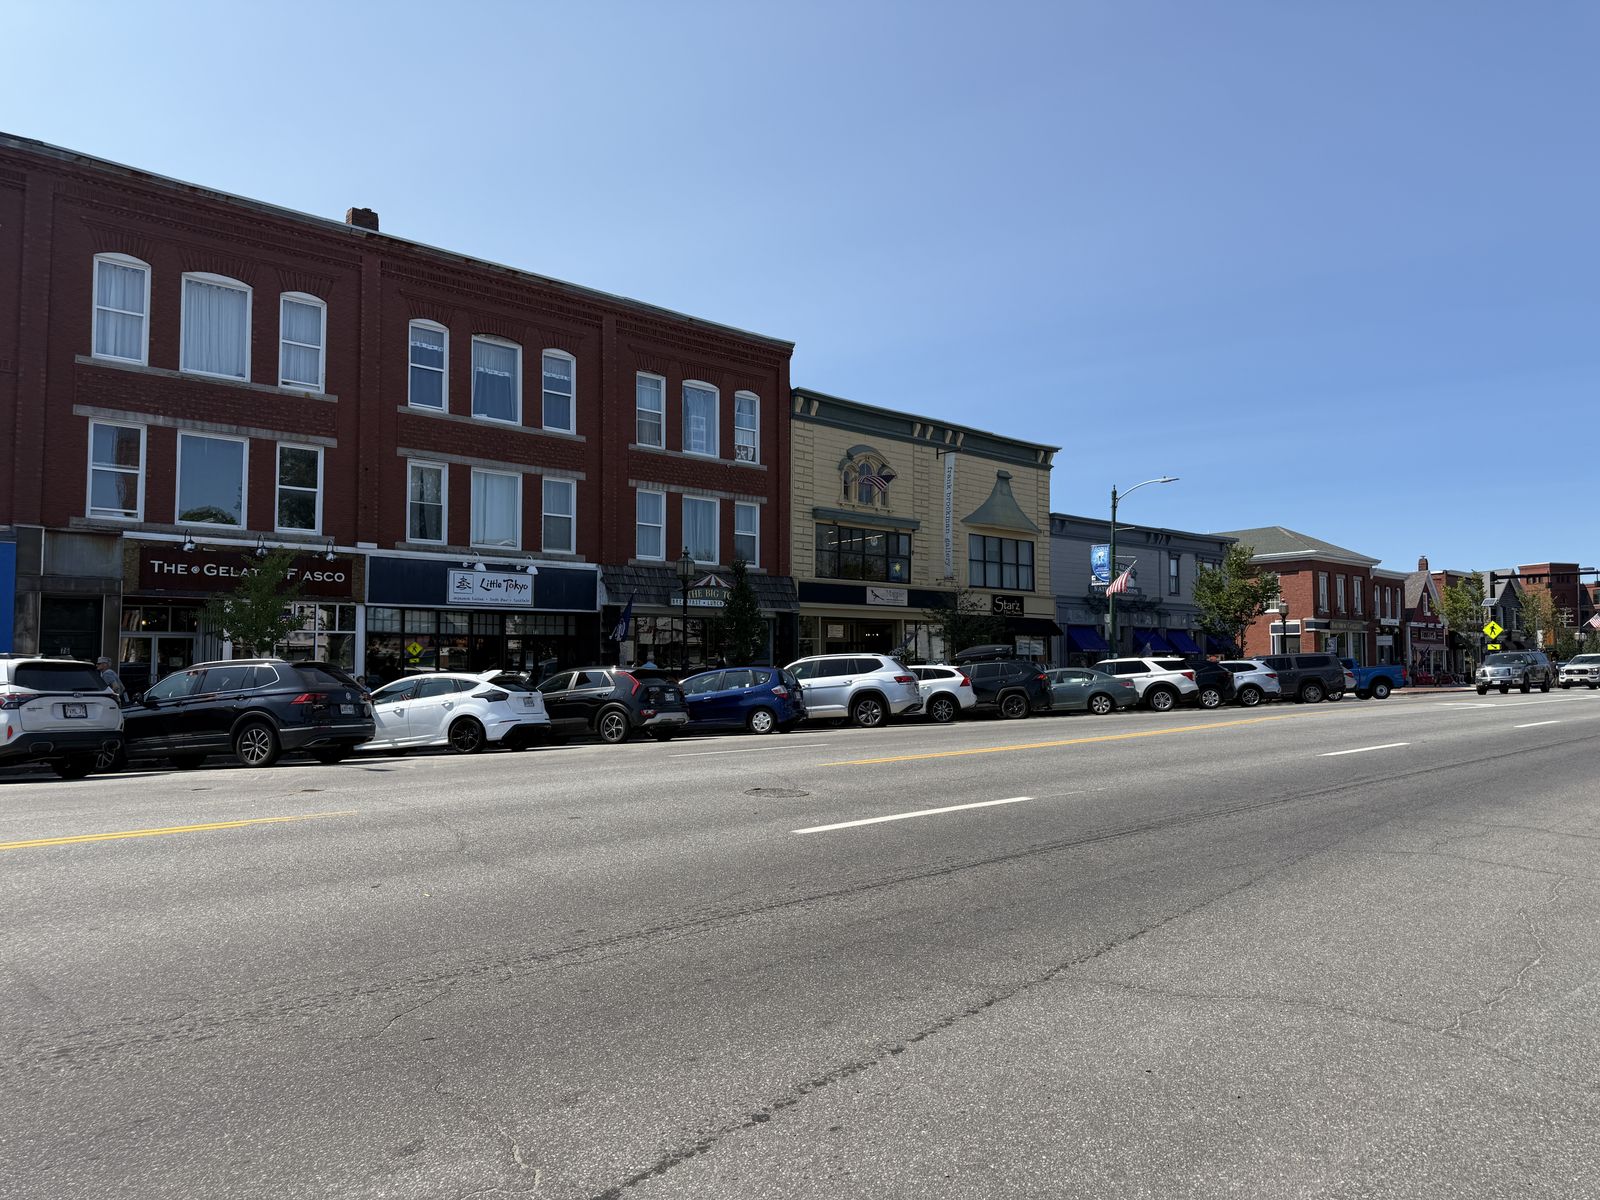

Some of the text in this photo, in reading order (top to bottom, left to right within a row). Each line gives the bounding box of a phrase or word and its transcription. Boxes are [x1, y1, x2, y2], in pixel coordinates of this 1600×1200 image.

[150, 560, 188, 575] THE
[203, 563, 270, 578] GELAT
[479, 578, 529, 594] Little Tokyo
[705, 588, 719, 598] BIG
